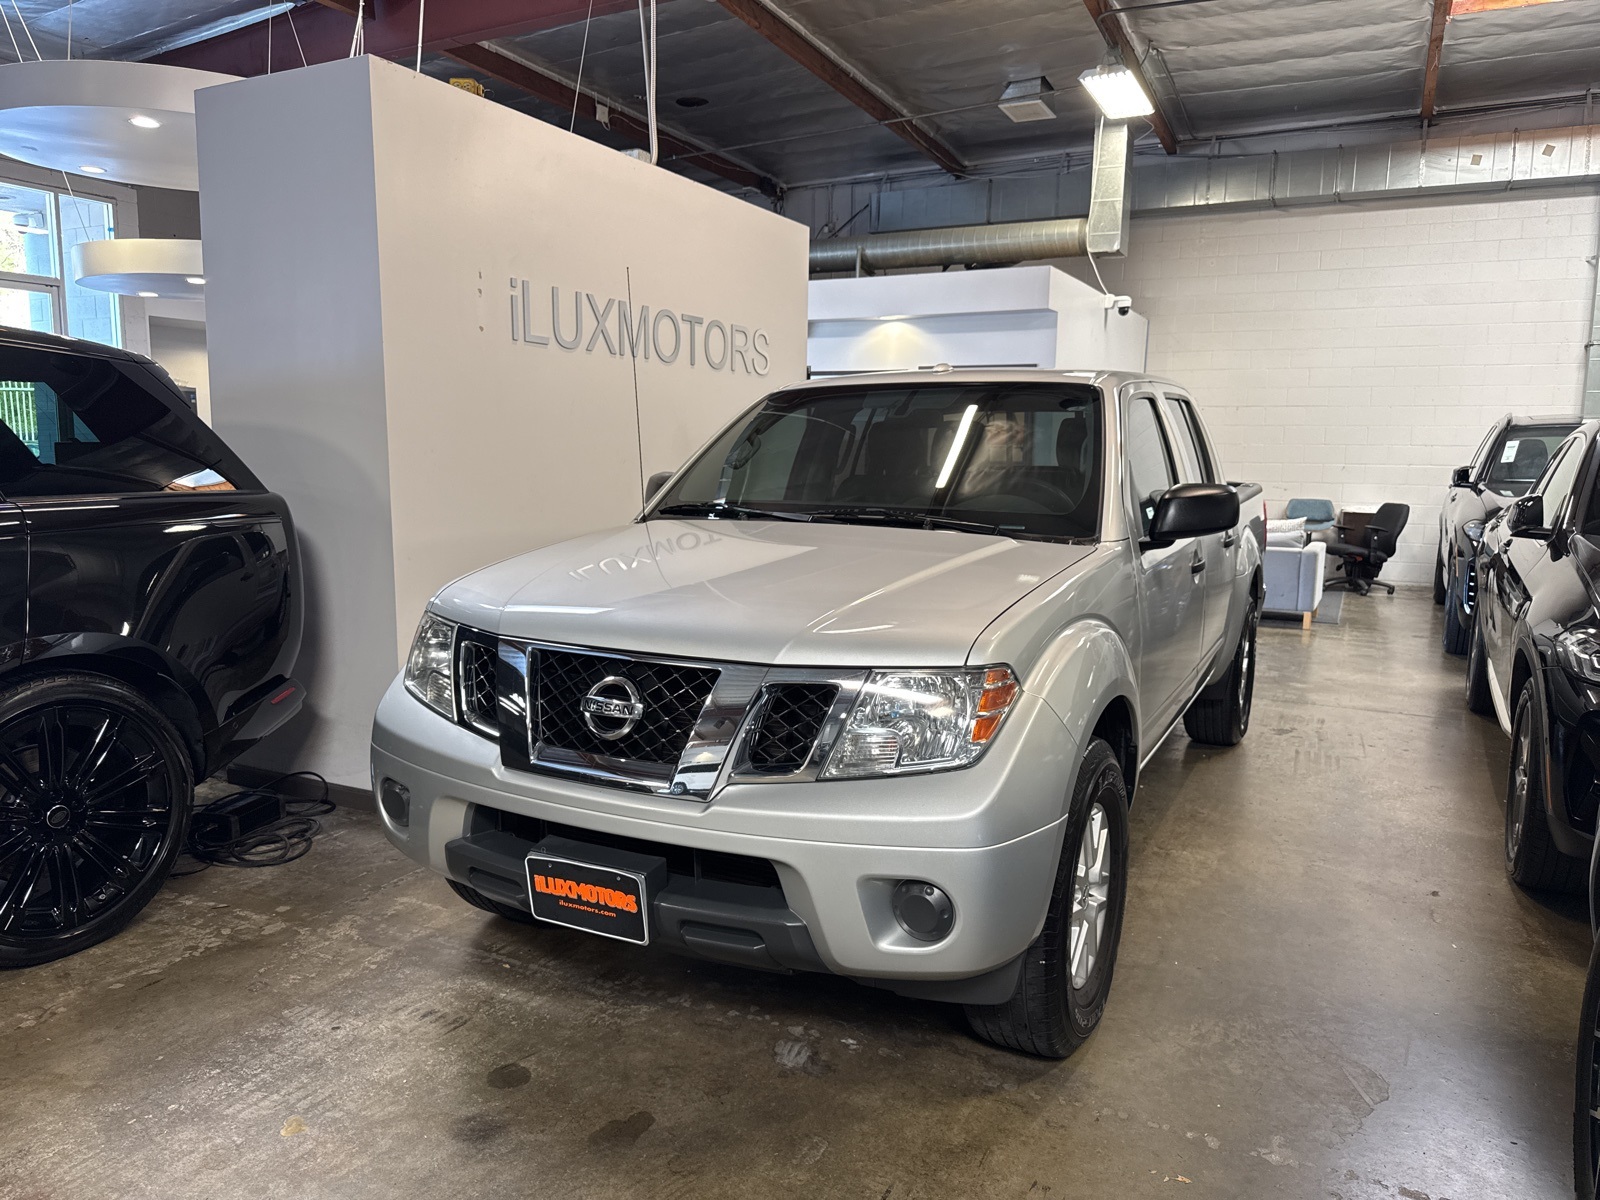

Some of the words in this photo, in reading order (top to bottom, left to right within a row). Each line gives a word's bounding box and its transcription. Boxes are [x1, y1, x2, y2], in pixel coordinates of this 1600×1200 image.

[510, 277, 770, 376] iLUXMOTORS
[585, 700, 633, 715] NISSAN
[534, 874, 638, 913] iLUXMOTORS
[558, 899, 616, 917] iluxmotors.com
